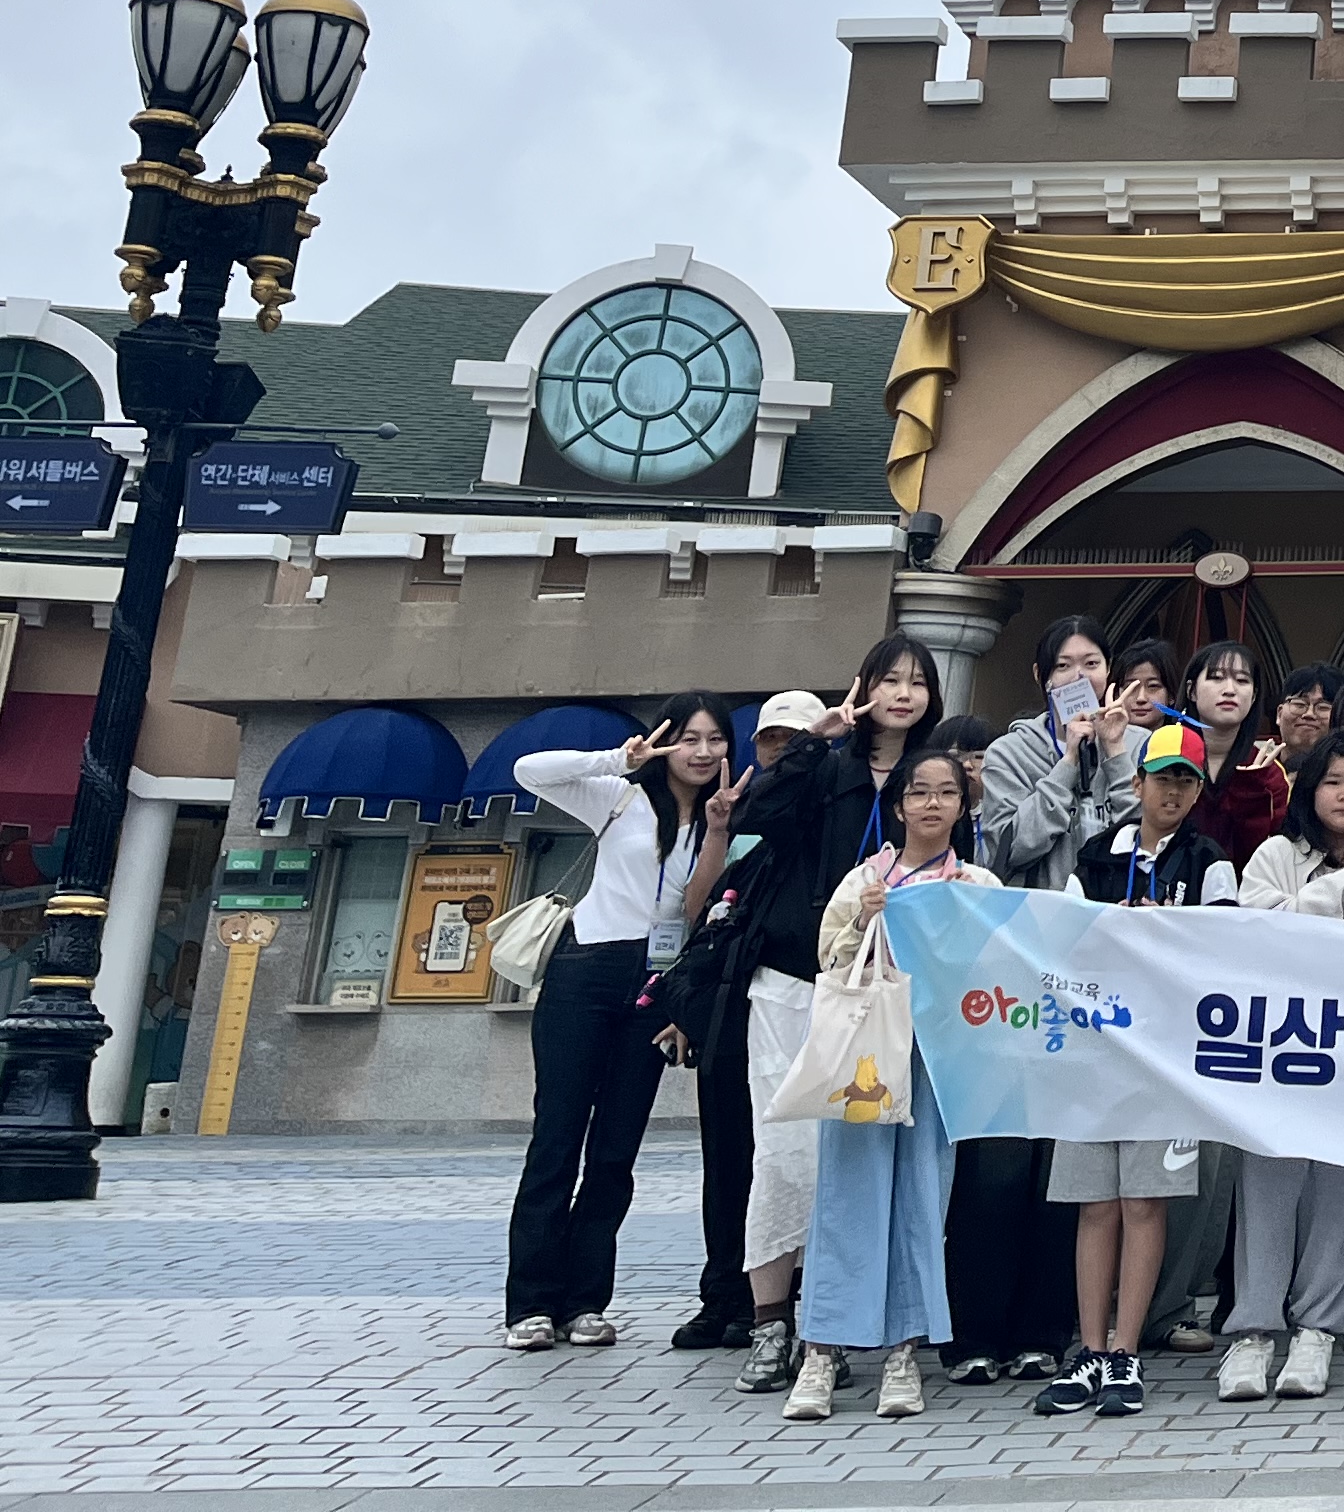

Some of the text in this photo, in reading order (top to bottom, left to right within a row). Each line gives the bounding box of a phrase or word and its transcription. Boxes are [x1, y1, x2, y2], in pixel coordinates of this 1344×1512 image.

[27, 460, 99, 482] 셔틀버스
[269, 471, 299, 485] 서비스
[302, 467, 334, 487] 센터
[1040, 972, 1100, 1001] 경남교육
